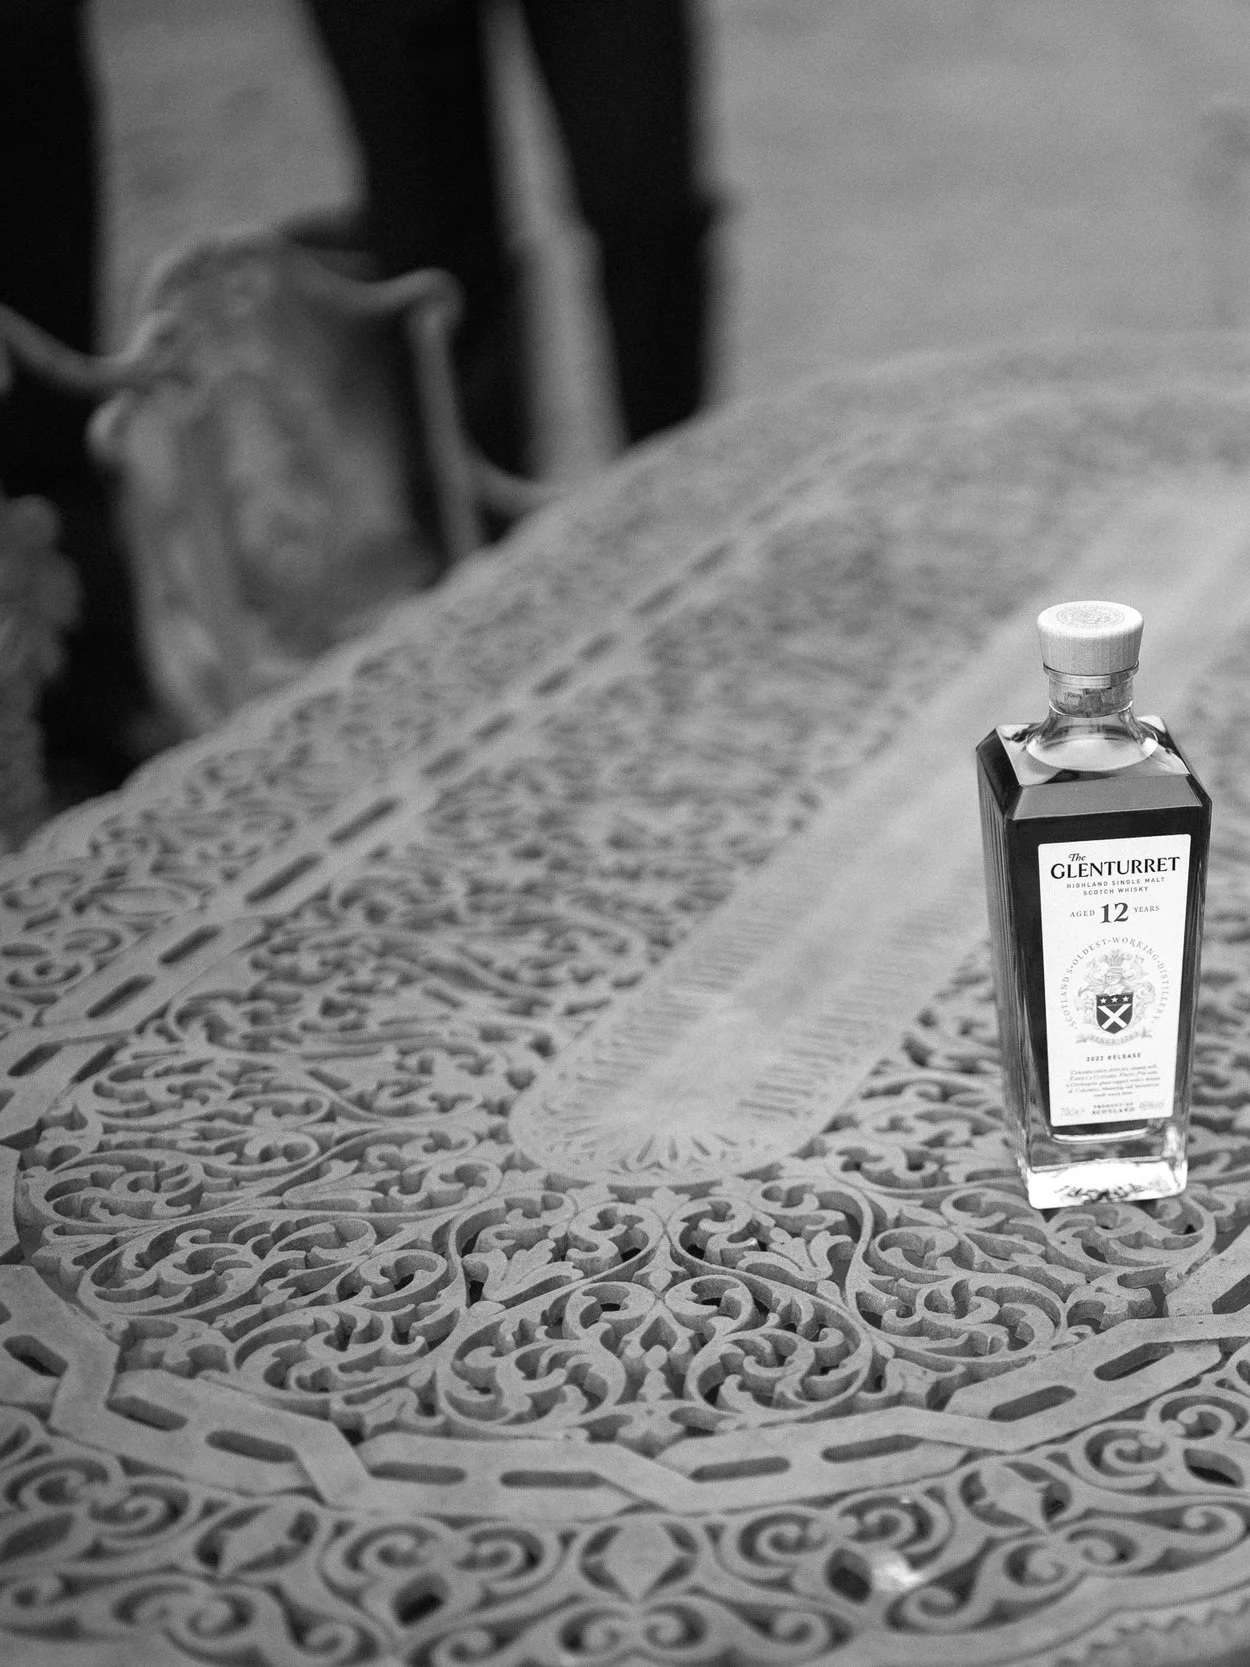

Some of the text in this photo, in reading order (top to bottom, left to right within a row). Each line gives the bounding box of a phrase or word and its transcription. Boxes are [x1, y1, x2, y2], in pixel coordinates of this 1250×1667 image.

[1068, 852, 1087, 862] The
[1050, 856, 1180, 880] GLENTURRET
[1066, 881, 1108, 889] HIGHLAND
[1111, 878, 1141, 886] SINGLE
[1069, 902, 1160, 924] AGED 12 YEARS
[1107, 1052, 1141, 1060] RELEASE
